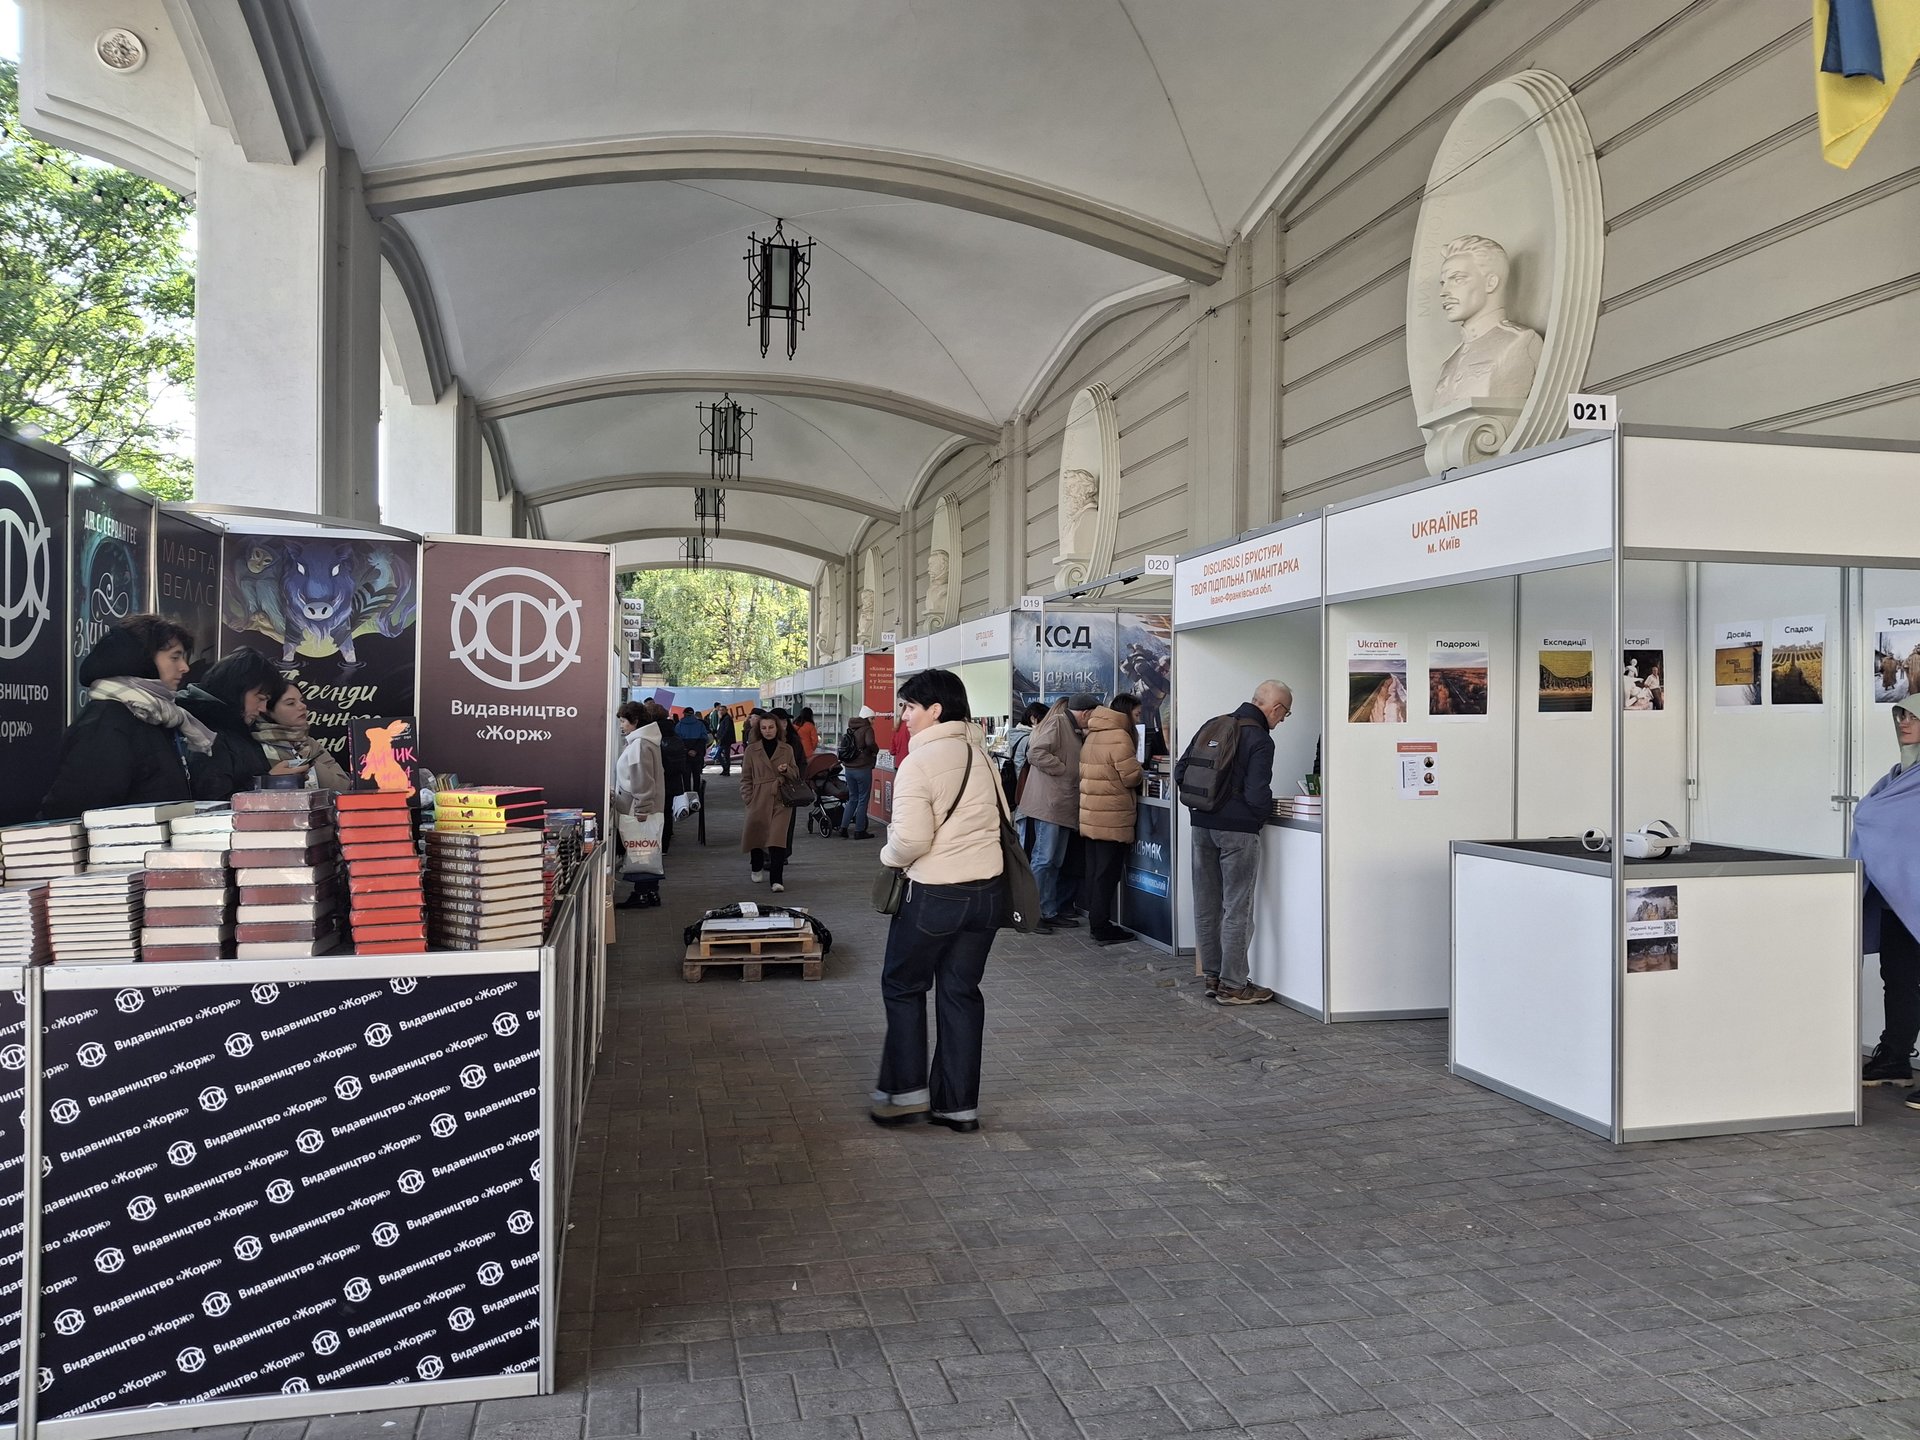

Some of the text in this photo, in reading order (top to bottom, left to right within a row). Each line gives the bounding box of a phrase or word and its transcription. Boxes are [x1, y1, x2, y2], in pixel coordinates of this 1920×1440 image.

[1574, 402, 1606, 420] 021
[1412, 508, 1478, 538] UKRAÏNER
[162, 539, 216, 577] МАРТА
[1204, 555, 1240, 577] DISCURSUS
[1244, 543, 1283, 566] БРУСТУРИ
[1427, 536, 1460, 554] м. Київ
[1148, 560, 1170, 570] 020
[1190, 558, 1300, 597] ТВОЯ ПІДПІЛЬНА ГУМАНІТАРКА
[163, 572, 215, 606] ВЕЛЛС
[624, 602, 642, 610] 003
[1023, 600, 1040, 608] 019
[1210, 586, 1259, 605] Івано-Франківська
[624, 618, 640, 626] 004
[1036, 625, 1092, 649] КСД
[1726, 630, 1752, 640] Досвід
[1784, 626, 1814, 634] Спадок
[1357, 640, 1398, 648] Ukraïner
[1436, 640, 1480, 649] Подорожі
[1543, 638, 1587, 647] Експедиції
[1624, 638, 1650, 647] Історії
[1032, 671, 1094, 684] ВДЬМАК
[451, 699, 578, 720] Видавництво
[476, 725, 552, 744] «Жорж»
[52, 1009, 98, 1029] «Жорж»
[261, 991, 382, 1040] Видавництво «Жорж»
[399, 981, 517, 1030] Видавництво «Жорж»
[114, 999, 240, 1050] Видавництво «Жорж»
[235, 1043, 357, 1094] Видавництво «Жорж»
[370, 1033, 488, 1083] Видавництво «Жорж»
[88, 1054, 215, 1106] Видавництво «Жорж»
[331, 1086, 450, 1136] Видавництво «Жорж»
[464, 1088, 536, 1121] Видавництво
[60, 1108, 188, 1162] Видавництво «Жорж»
[204, 1096, 327, 1148] Видавництво «Жорж»
[164, 1150, 288, 1203] Видавництво «Жорж»
[302, 1135, 421, 1186] Видавництво «Жорж»
[432, 1144, 504, 1177] Видавництво
[42, 1163, 157, 1214] давництво «Жорж»
[406, 1178, 522, 1230] Видавництво «Жорж»
[63, 1221, 110, 1243] «Жорж»
[132, 1200, 258, 1254] Видавництво «Жорж»
[270, 1190, 390, 1243] Видавництво «Жорж»
[238, 1244, 360, 1299] Видавництво «Жорж»
[378, 1232, 496, 1284] Видавництво «Жорж»
[93, 1259, 222, 1316] Видавництво «Жорж»
[214, 1298, 336, 1354] Видавництво «Жорж»
[347, 1284, 465, 1337] Видавництво «Жорж»
[63, 1314, 194, 1373] Видавництво «Жорж»
[317, 1329, 436, 1384] Видавництво «Жорж»
[451, 1328, 522, 1362] Видавництво
[260, 1352, 304, 1374] «Жорж»
[119, 1370, 166, 1394] «Жорж»
